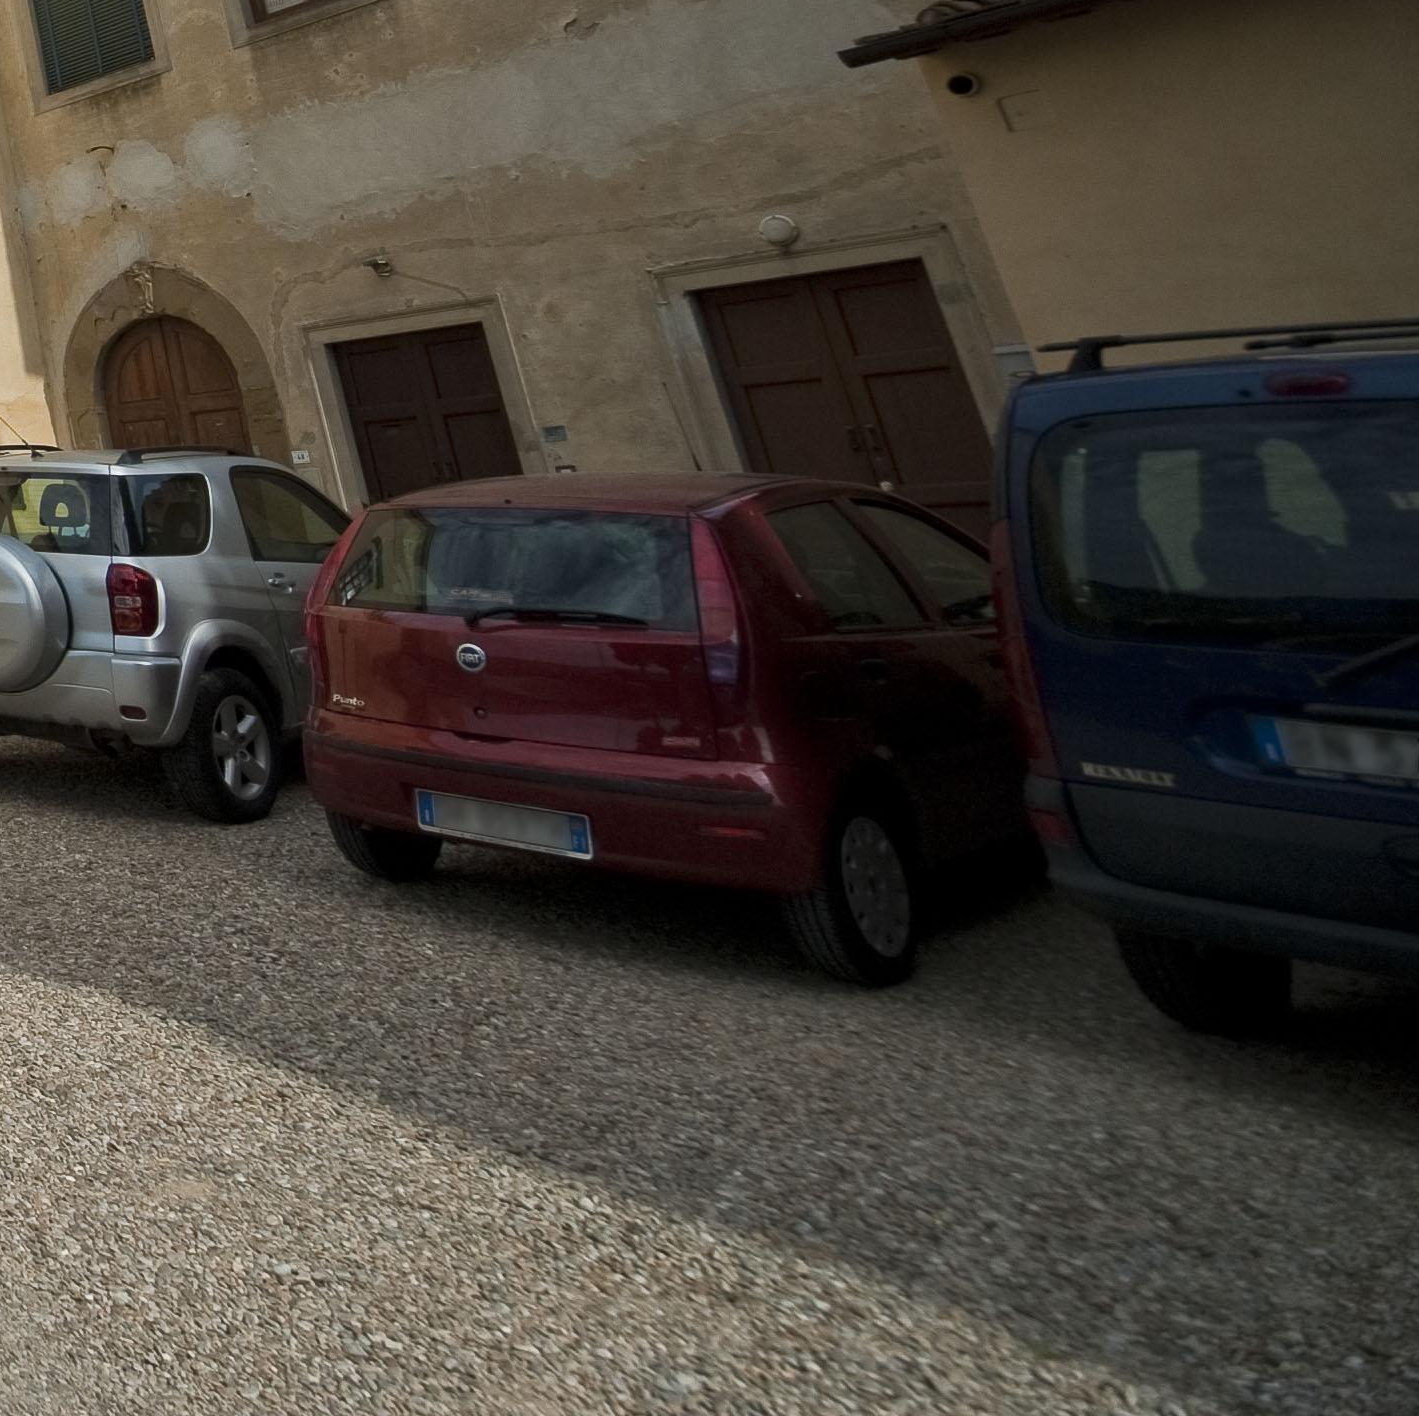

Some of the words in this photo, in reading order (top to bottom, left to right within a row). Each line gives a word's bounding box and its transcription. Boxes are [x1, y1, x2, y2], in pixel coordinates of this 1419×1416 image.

[460, 652, 480, 664] FIAT
[332, 694, 365, 707] Punto
[1081, 762, 1176, 787] RENAULT
